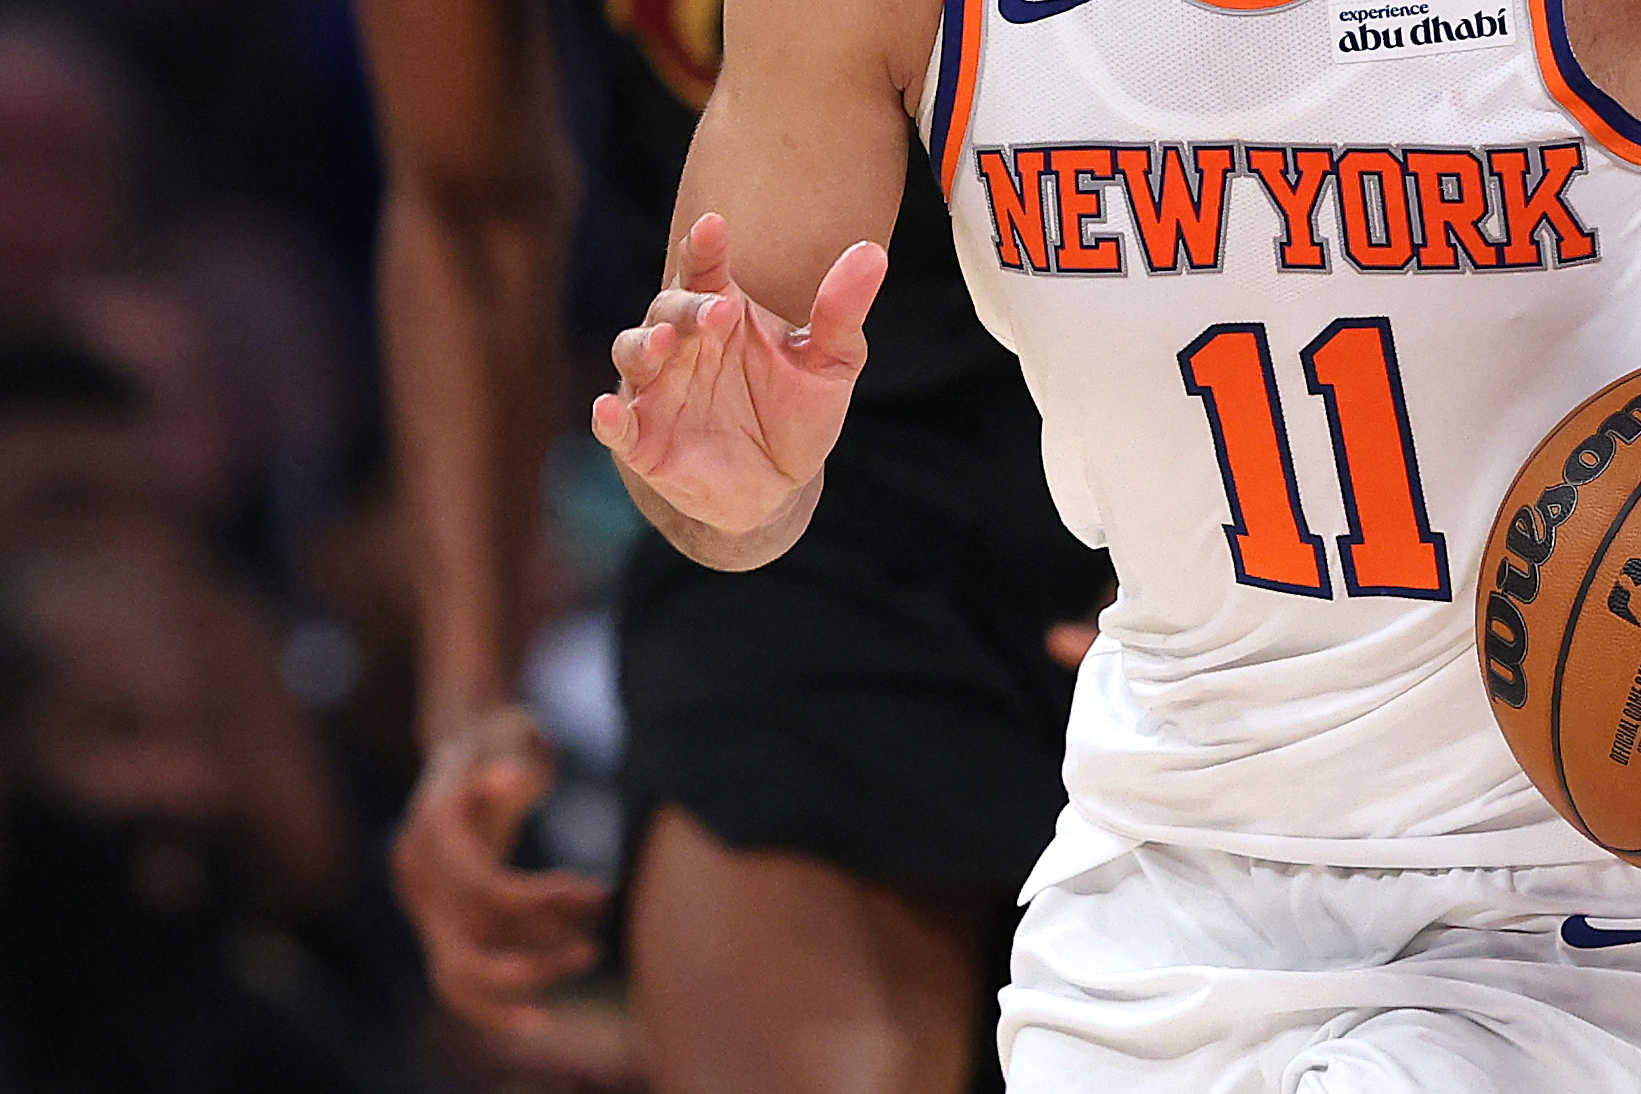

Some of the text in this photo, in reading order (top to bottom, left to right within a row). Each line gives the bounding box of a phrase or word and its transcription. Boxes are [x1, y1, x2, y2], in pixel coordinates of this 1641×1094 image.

[1339, 3, 1429, 23] experience
[1338, 23, 1405, 52] abu
[973, 137, 1602, 277] NEW YORK
[1176, 316, 1452, 602] 11
[1609, 718, 1641, 766] OFFICIAL
